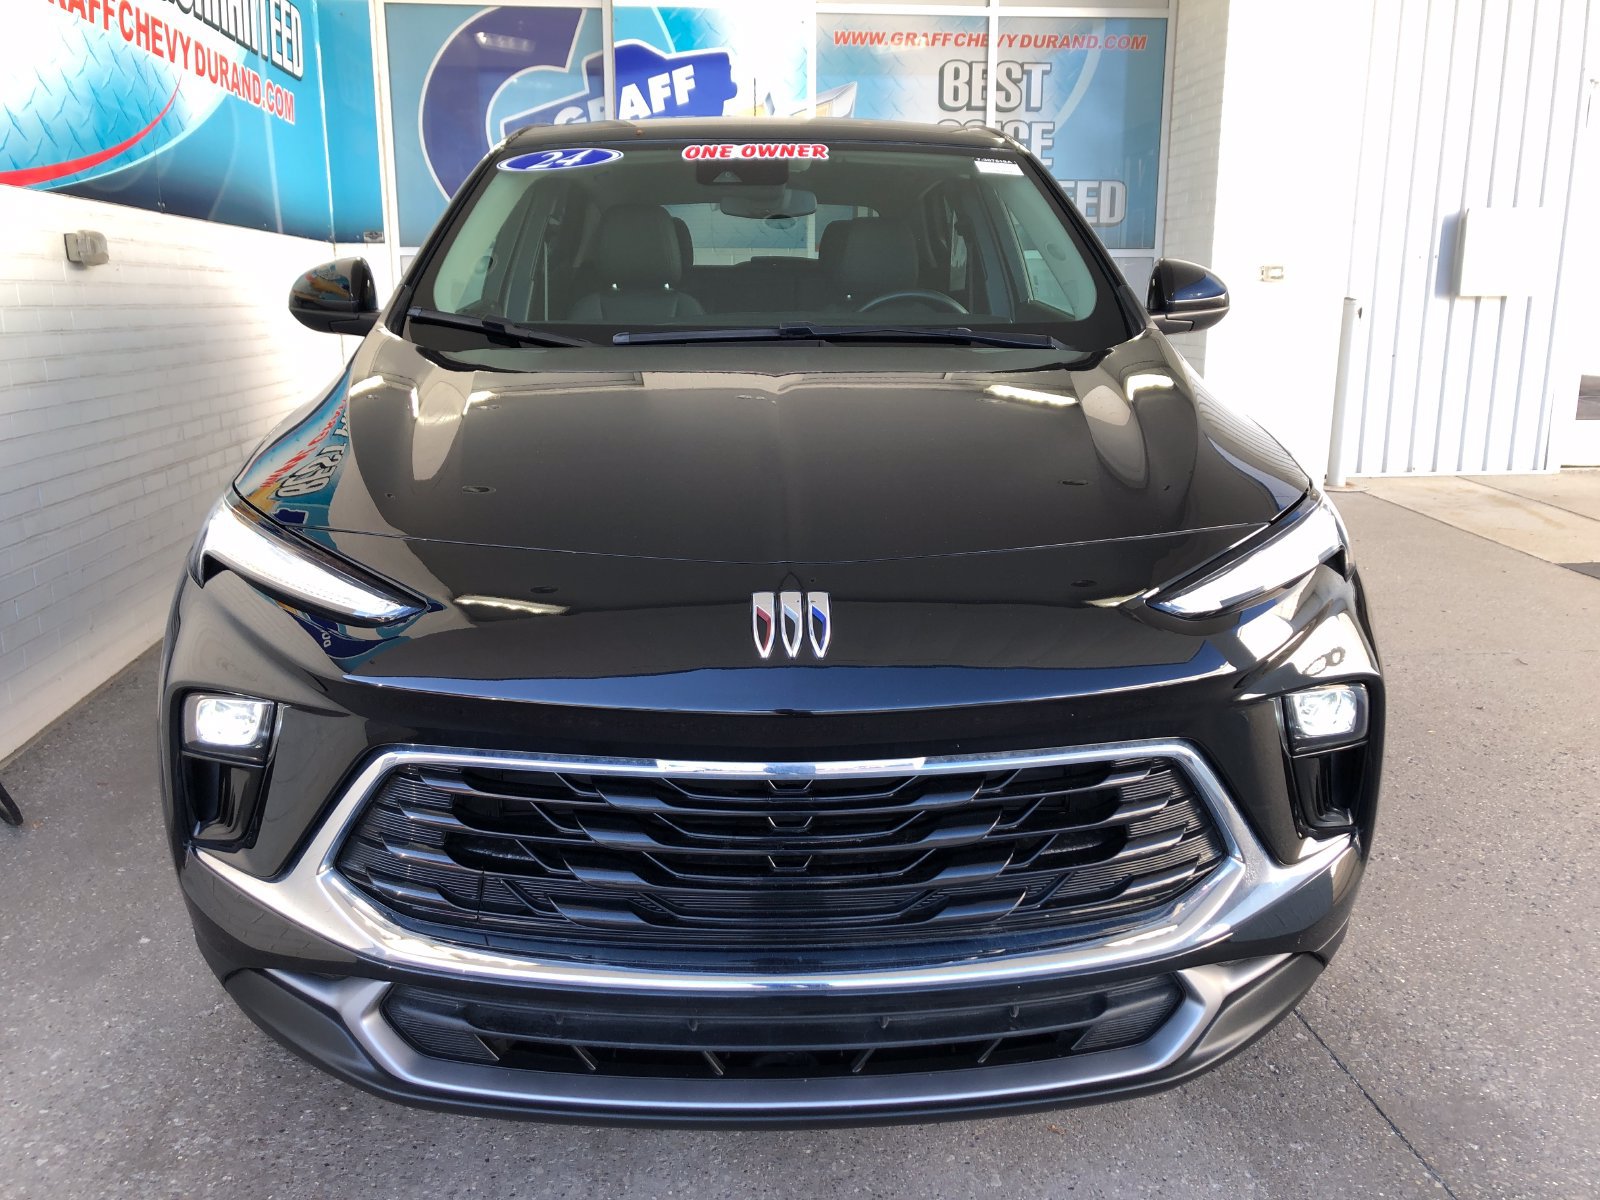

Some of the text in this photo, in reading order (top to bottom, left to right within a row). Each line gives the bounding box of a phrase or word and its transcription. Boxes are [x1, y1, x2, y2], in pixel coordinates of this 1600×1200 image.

[48, 0, 295, 124] FFCHEVYDURAND.COM
[938, 59, 1052, 112] BEST
[525, 149, 593, 170] 24
[684, 144, 827, 159] ONE OWNER
